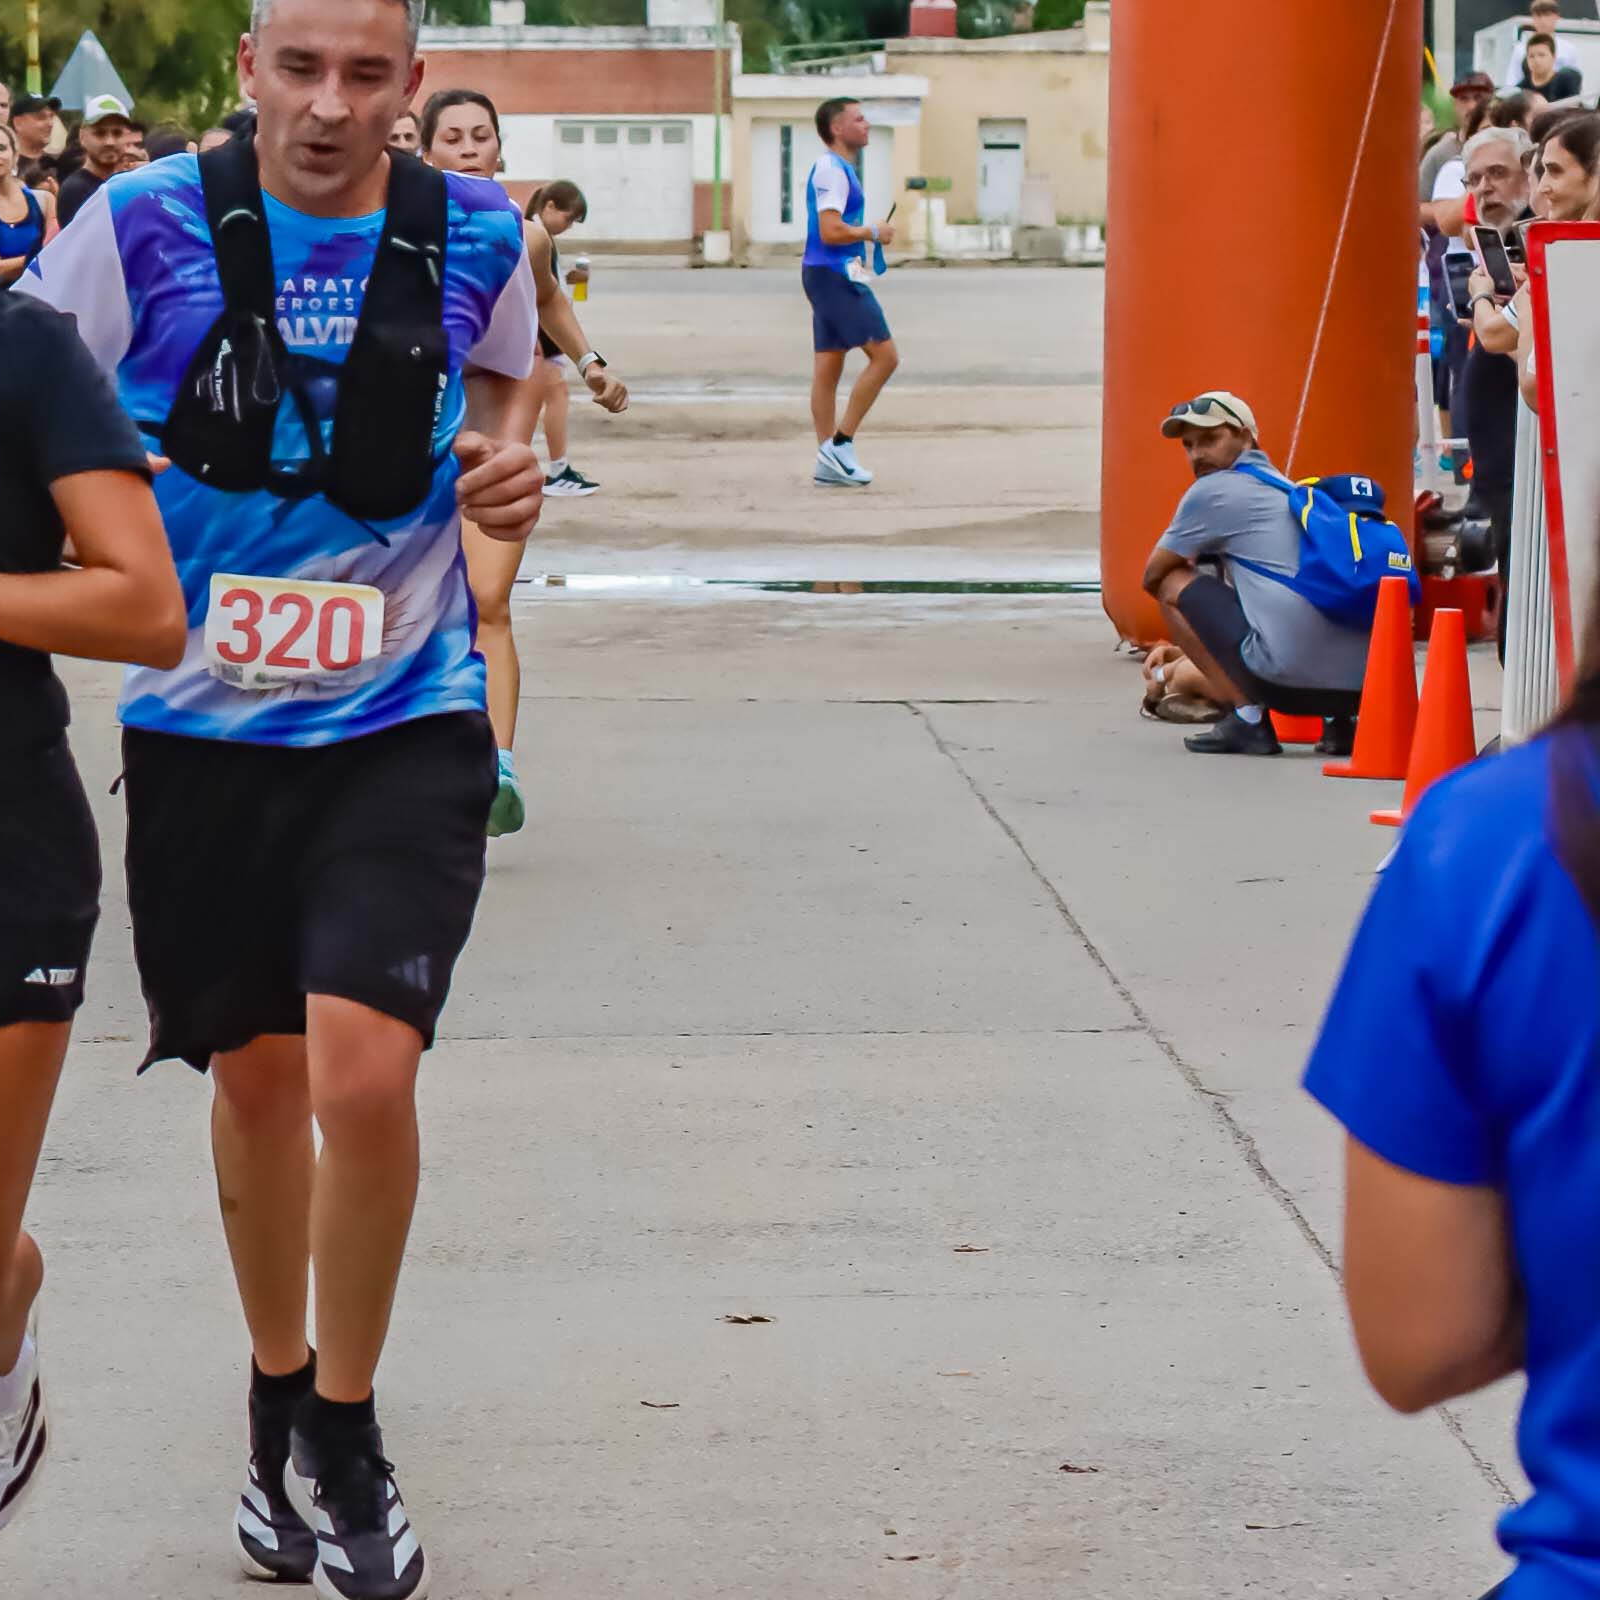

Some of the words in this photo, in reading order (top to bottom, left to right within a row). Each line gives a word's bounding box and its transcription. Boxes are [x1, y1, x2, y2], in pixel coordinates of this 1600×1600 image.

[282, 275, 369, 293] ARAT
[275, 294, 355, 312] ÉROES
[216, 587, 366, 672] 320
